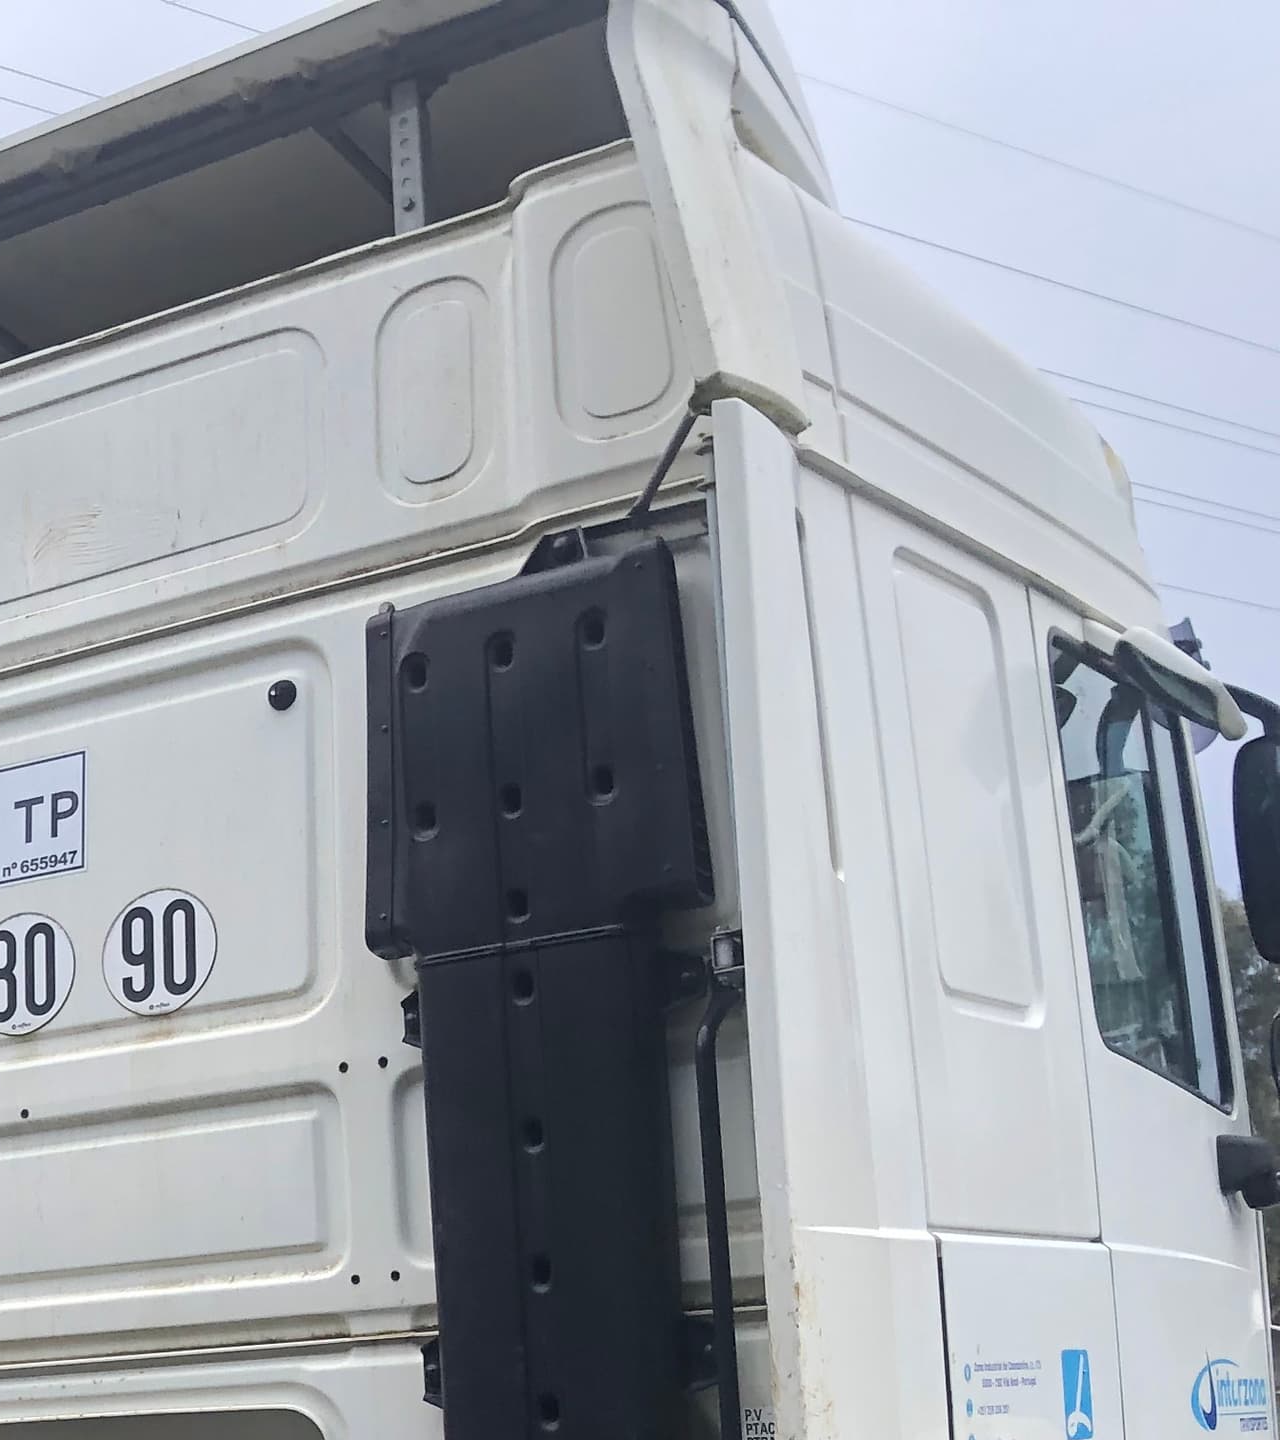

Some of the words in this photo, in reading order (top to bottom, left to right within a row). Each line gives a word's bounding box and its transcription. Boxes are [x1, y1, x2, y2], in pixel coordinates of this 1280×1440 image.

[13, 790, 80, 844] TP
[20, 850, 78, 873] 655947
[121, 898, 196, 1003] 90
[745, 1422, 776, 1436] PTAC
